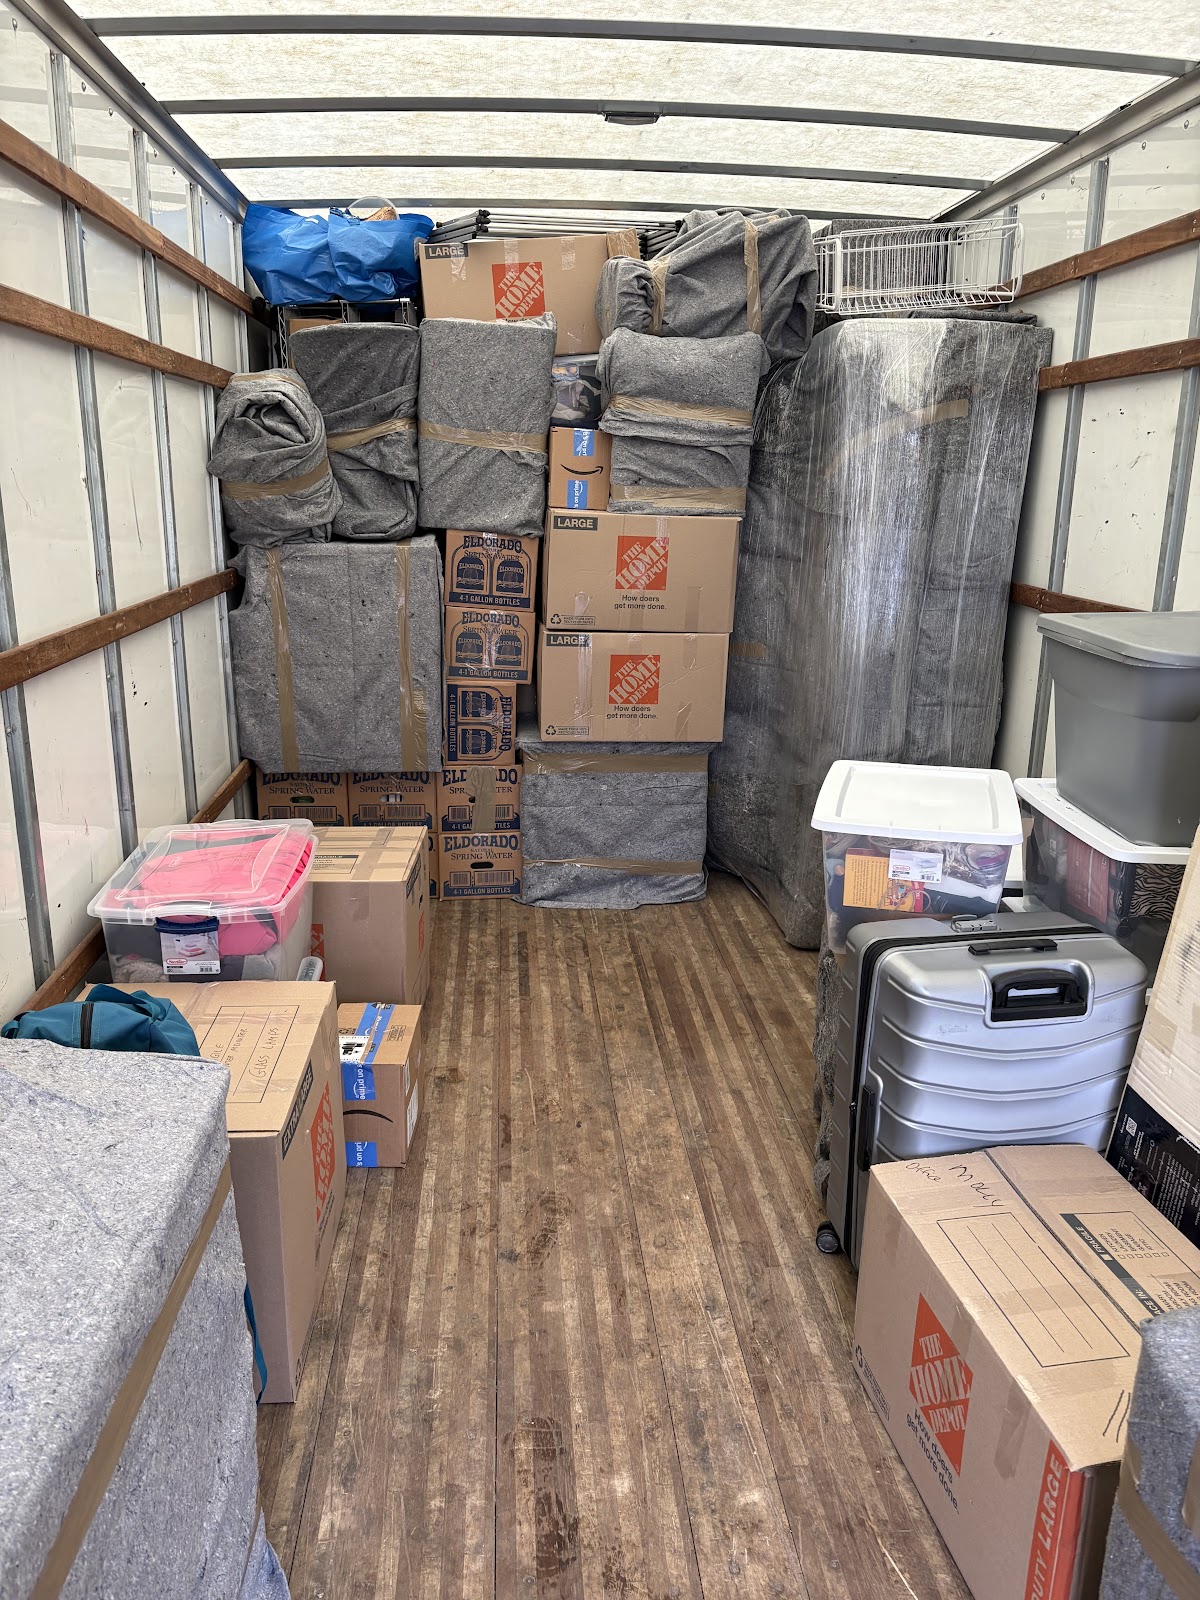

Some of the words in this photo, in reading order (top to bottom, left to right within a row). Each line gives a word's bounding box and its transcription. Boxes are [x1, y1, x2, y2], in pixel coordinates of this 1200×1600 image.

[429, 245, 464, 257] LARGE
[495, 262, 543, 318] HOME
[498, 268, 520, 292] THE
[514, 281, 544, 317] DEPOT
[557, 518, 593, 528] LARGE
[463, 535, 522, 553] ELDORADO
[621, 541, 644, 563] THE
[615, 537, 669, 589] HOME
[634, 557, 668, 592] DEPOT
[470, 595, 493, 603] GALLON
[494, 597, 521, 606] BOTTLES
[461, 611, 520, 628] ELDORADO
[550, 635, 585, 645] LARGE
[469, 669, 492, 677] GALLON
[609, 655, 660, 704] HOME
[615, 660, 636, 680] THE
[628, 673, 660, 704] DEPOT
[499, 696, 513, 752] ELDORADO
[269, 786, 303, 795] SPRING
[306, 787, 335, 795] WATER
[360, 785, 393, 793] SPRING
[396, 785, 424, 793] WATER
[443, 834, 519, 852] ELDORADO
[357, 1079, 366, 1100] prime
[1075, 1226, 1105, 1253] FRAGILE
[919, 1332, 943, 1360] THE
[910, 1354, 971, 1407] HOME
[928, 1404, 966, 1433] DEPOT
[906, 1413, 919, 1438] get
[919, 1436, 938, 1472] more
[914, 1408, 931, 1441] How
[931, 1442, 953, 1484] doers
[1038, 1453, 1063, 1551] LARGE
